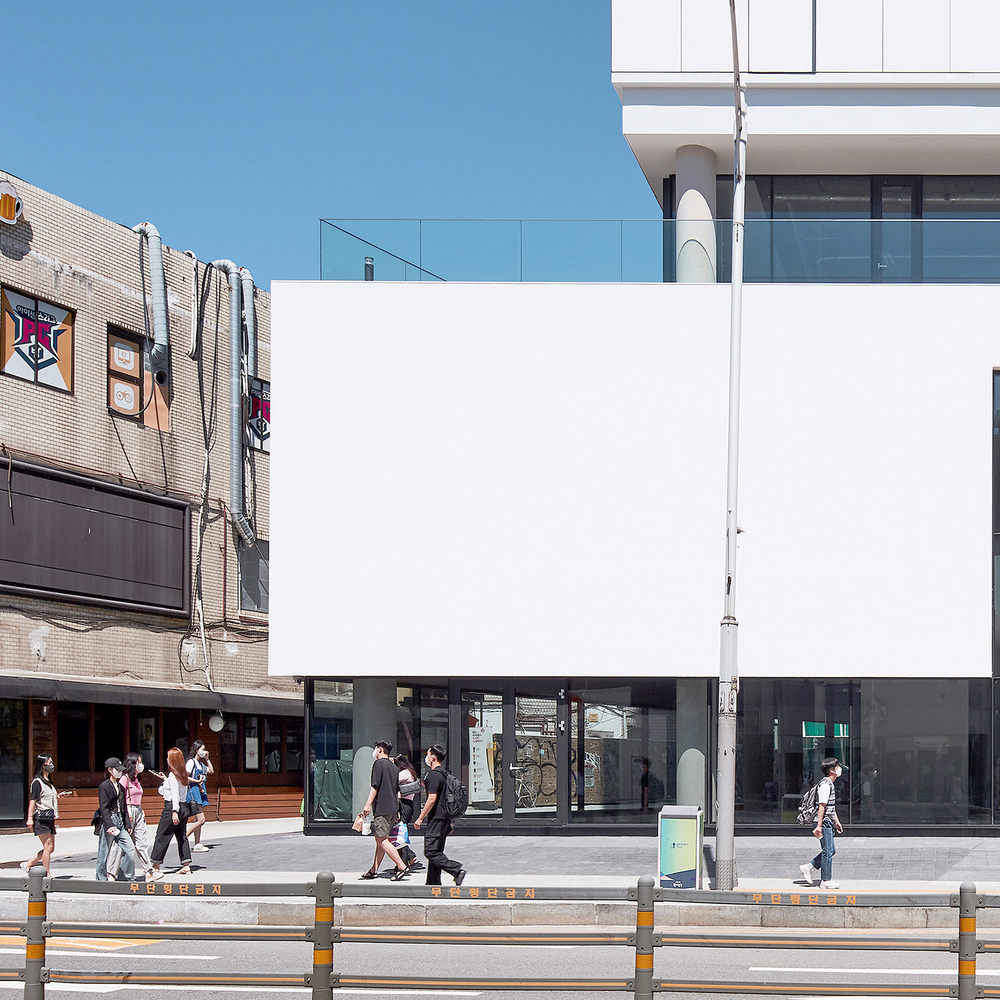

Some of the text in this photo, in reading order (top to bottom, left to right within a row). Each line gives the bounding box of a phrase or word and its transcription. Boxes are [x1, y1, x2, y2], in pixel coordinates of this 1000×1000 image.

[20, 317, 52, 351] PC
[129, 883, 221, 894] 무단횡단금지
[431, 887, 535, 898] 무단횡단금지
[752, 893, 856, 905] 무단횡단금지
